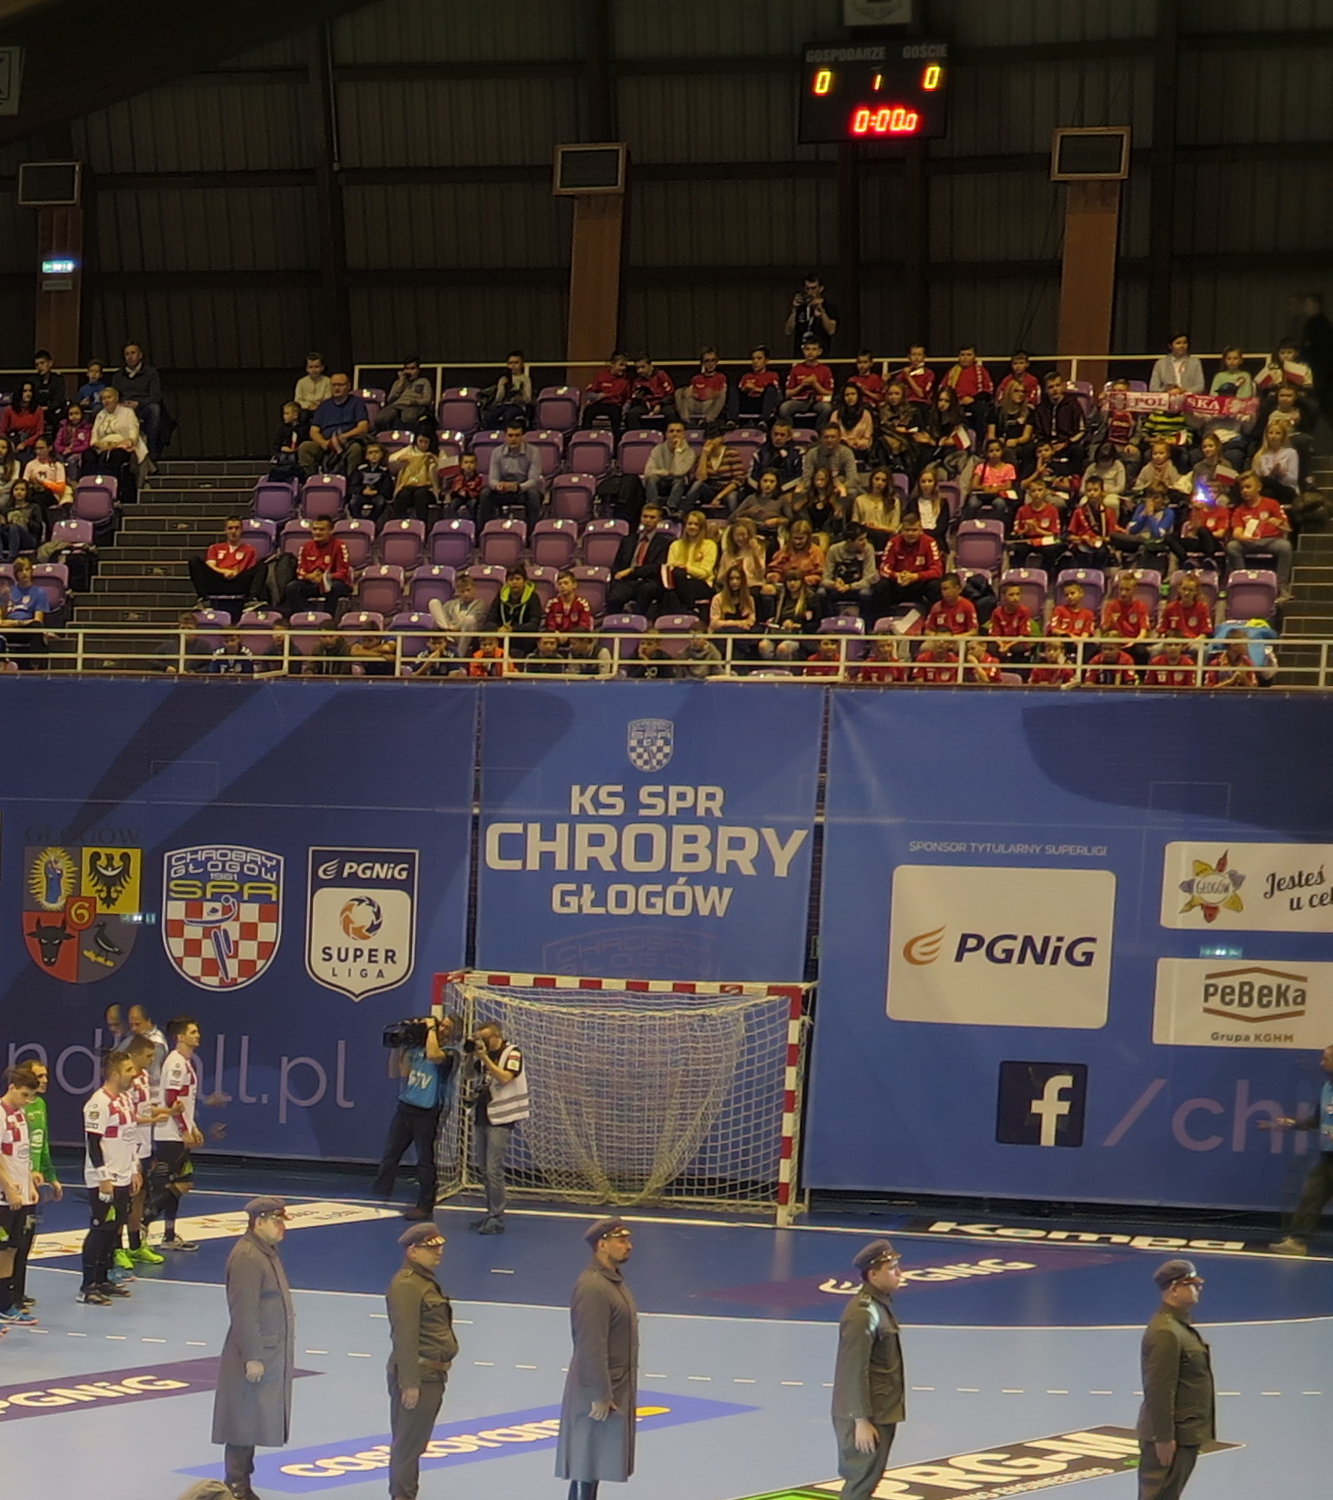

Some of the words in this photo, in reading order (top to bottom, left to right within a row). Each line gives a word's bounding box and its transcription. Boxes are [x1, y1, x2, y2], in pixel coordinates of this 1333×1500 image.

[806, 47, 886, 63] GOSPODARZE
[814, 69, 832, 95] 0
[923, 65, 941, 90] 0
[570, 784, 625, 816] KS
[638, 784, 725, 818] SPR
[484, 822, 809, 878] CHROBRY
[909, 841, 967, 854] SPONSOR
[969, 842, 1043, 855] TYTULARNY
[1045, 843, 1108, 857] SUPERLIGI
[342, 861, 410, 880] PGNiG
[1263, 864, 1326, 899] Jesteś
[551, 877, 733, 918] GŁOGÓW
[1289, 896, 1304, 911] u
[320, 946, 398, 964] SUPER
[954, 932, 1097, 968] PGNiG
[331, 967, 386, 979] LIGA
[1203, 981, 1307, 1009] PeBeKa
[1210, 1031, 1250, 1044] Grupa
[1253, 1032, 1294, 1044] KGHM
[928, 1220, 1245, 1251] Kempa
[899, 1258, 1036, 1287] GNiG
